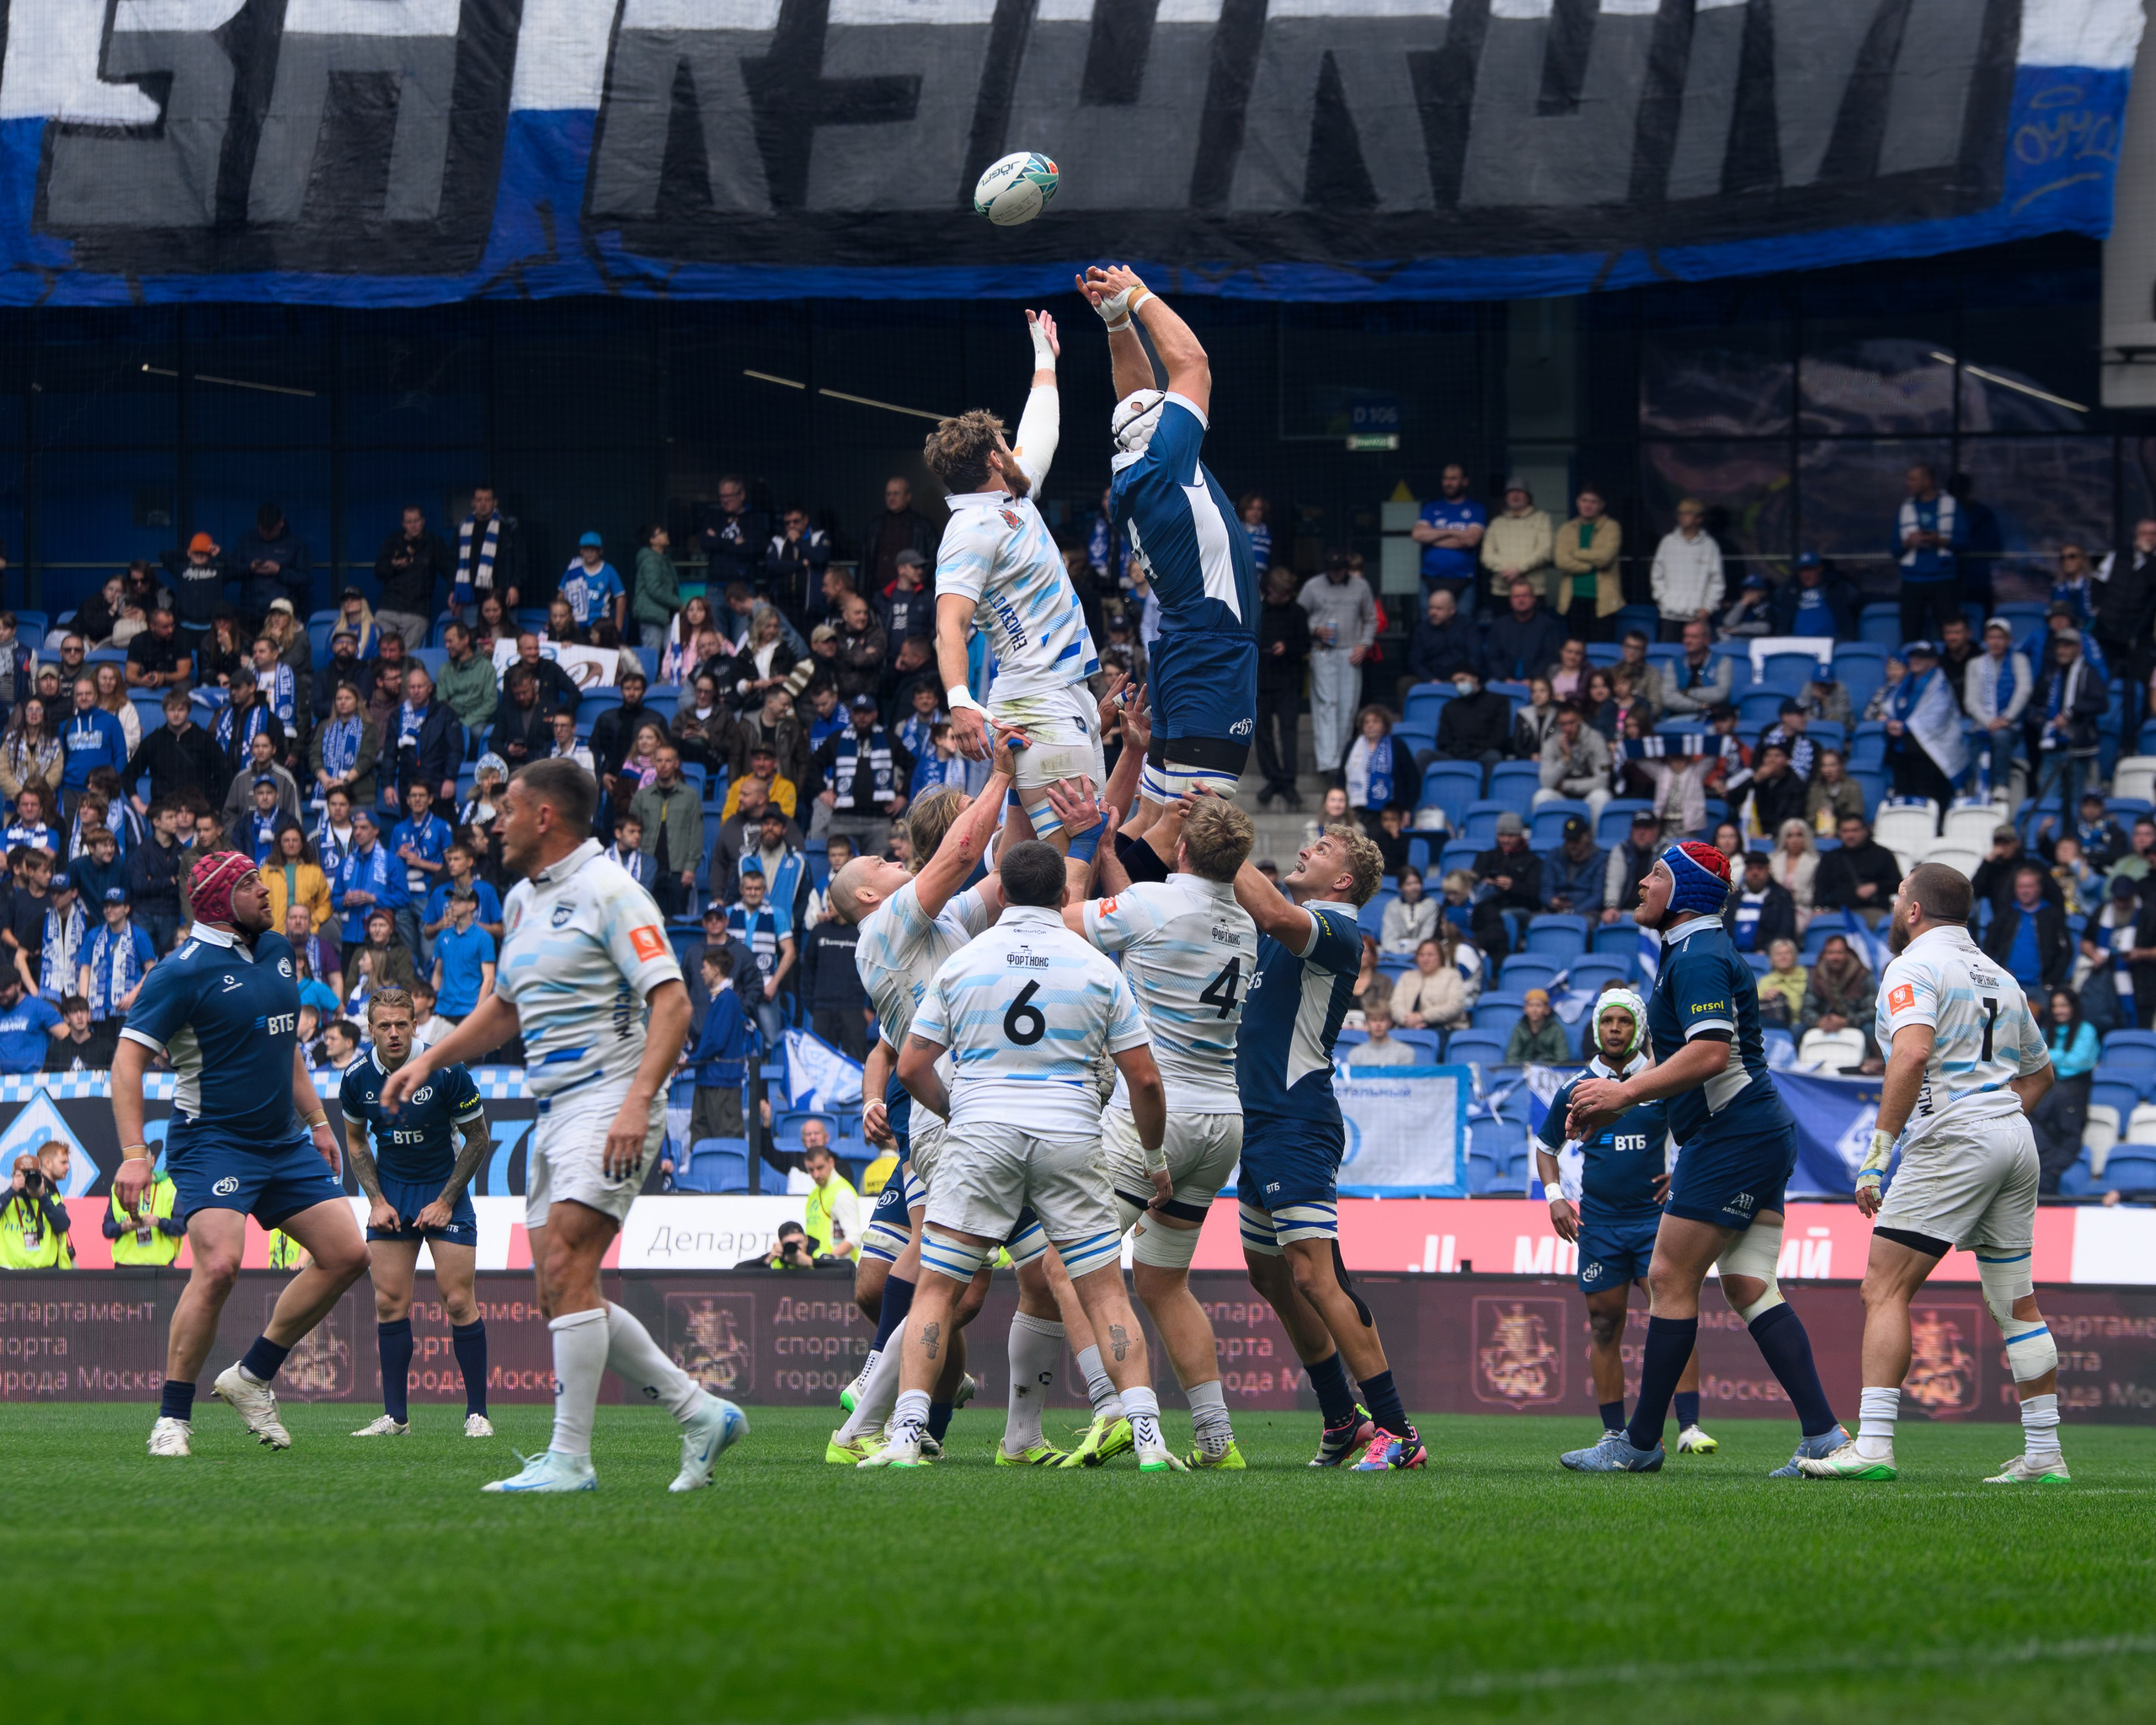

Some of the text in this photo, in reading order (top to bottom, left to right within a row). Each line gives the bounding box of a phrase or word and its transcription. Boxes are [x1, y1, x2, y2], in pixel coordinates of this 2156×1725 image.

[979, 160, 1021, 186] JÖGEL
[1198, 956, 1241, 1019] 4
[268, 1012, 295, 1035] ВТБ
[1004, 979, 1045, 1045] 6
[393, 1130, 424, 1145] ВТБ
[1614, 1134, 1646, 1151] ВТБ
[1266, 1182, 1280, 1194] ВТБ
[648, 1226, 776, 1258] Департ
[775, 1337, 869, 1362] спорта
[78, 1365, 168, 1391] Москв
